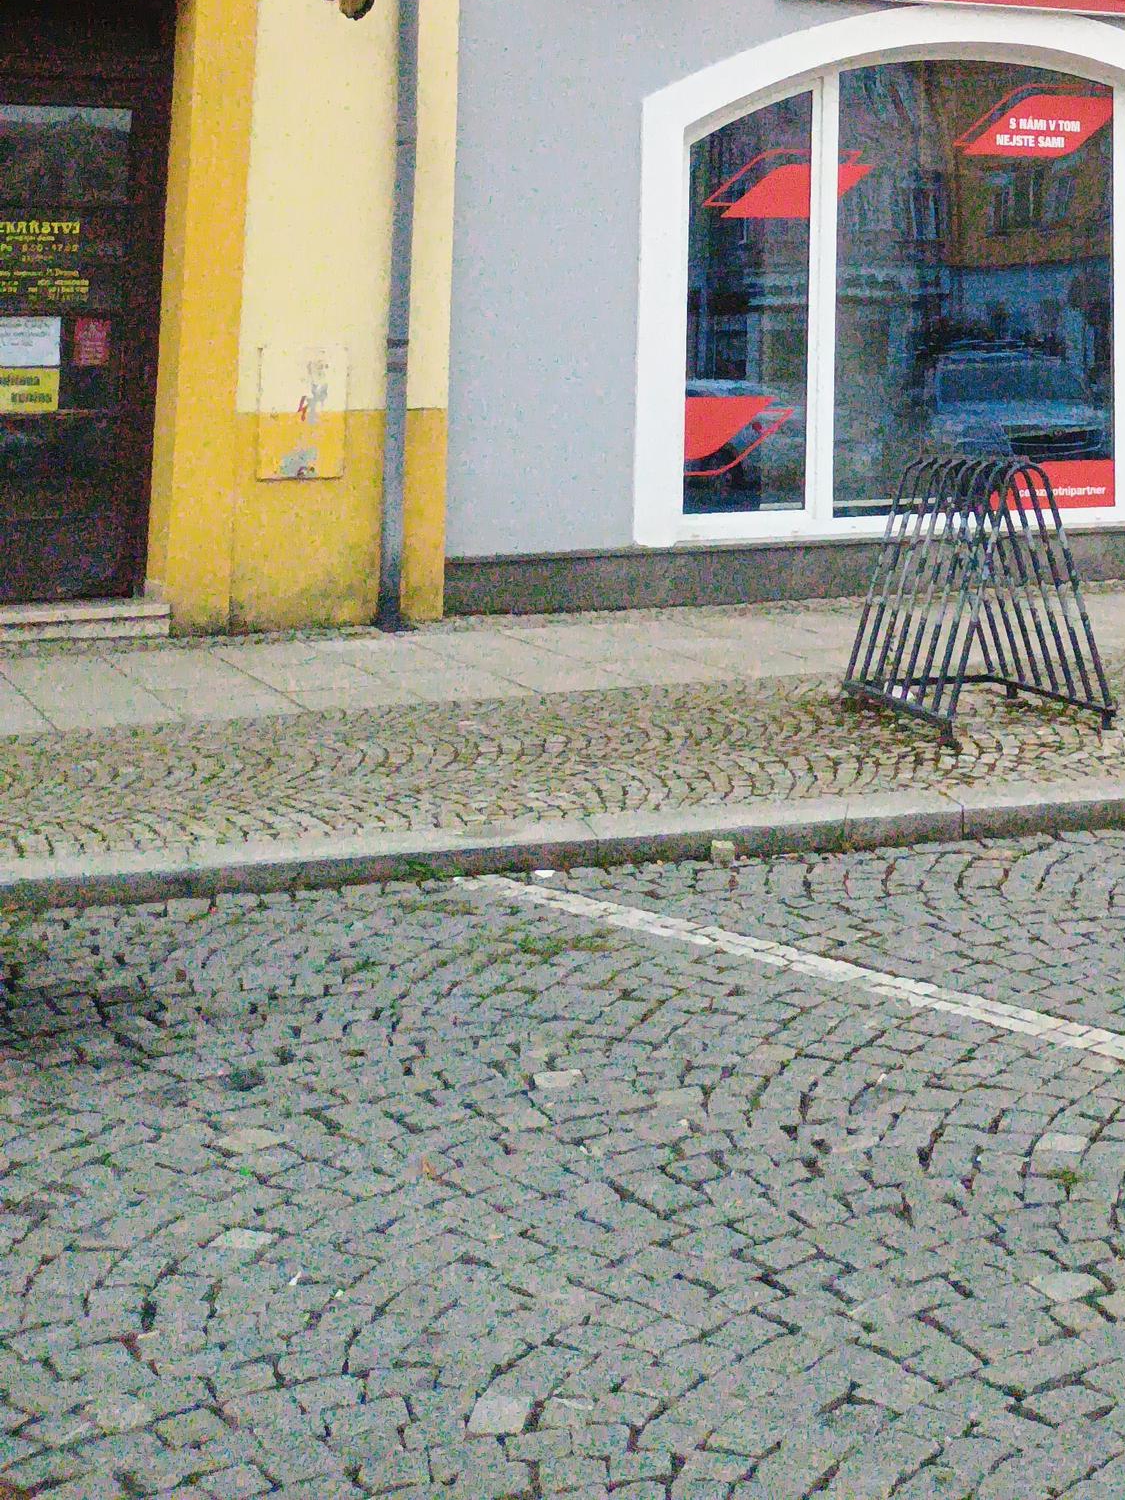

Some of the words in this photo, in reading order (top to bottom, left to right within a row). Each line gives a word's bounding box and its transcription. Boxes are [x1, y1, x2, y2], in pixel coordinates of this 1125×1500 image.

[1009, 117, 1017, 130] S
[1019, 116, 1047, 131] NÁMI
[1048, 120, 1057, 131] V
[1058, 120, 1081, 132] TOM
[996, 134, 1035, 147] NEJSTE
[1037, 136, 1065, 148] SAMI
